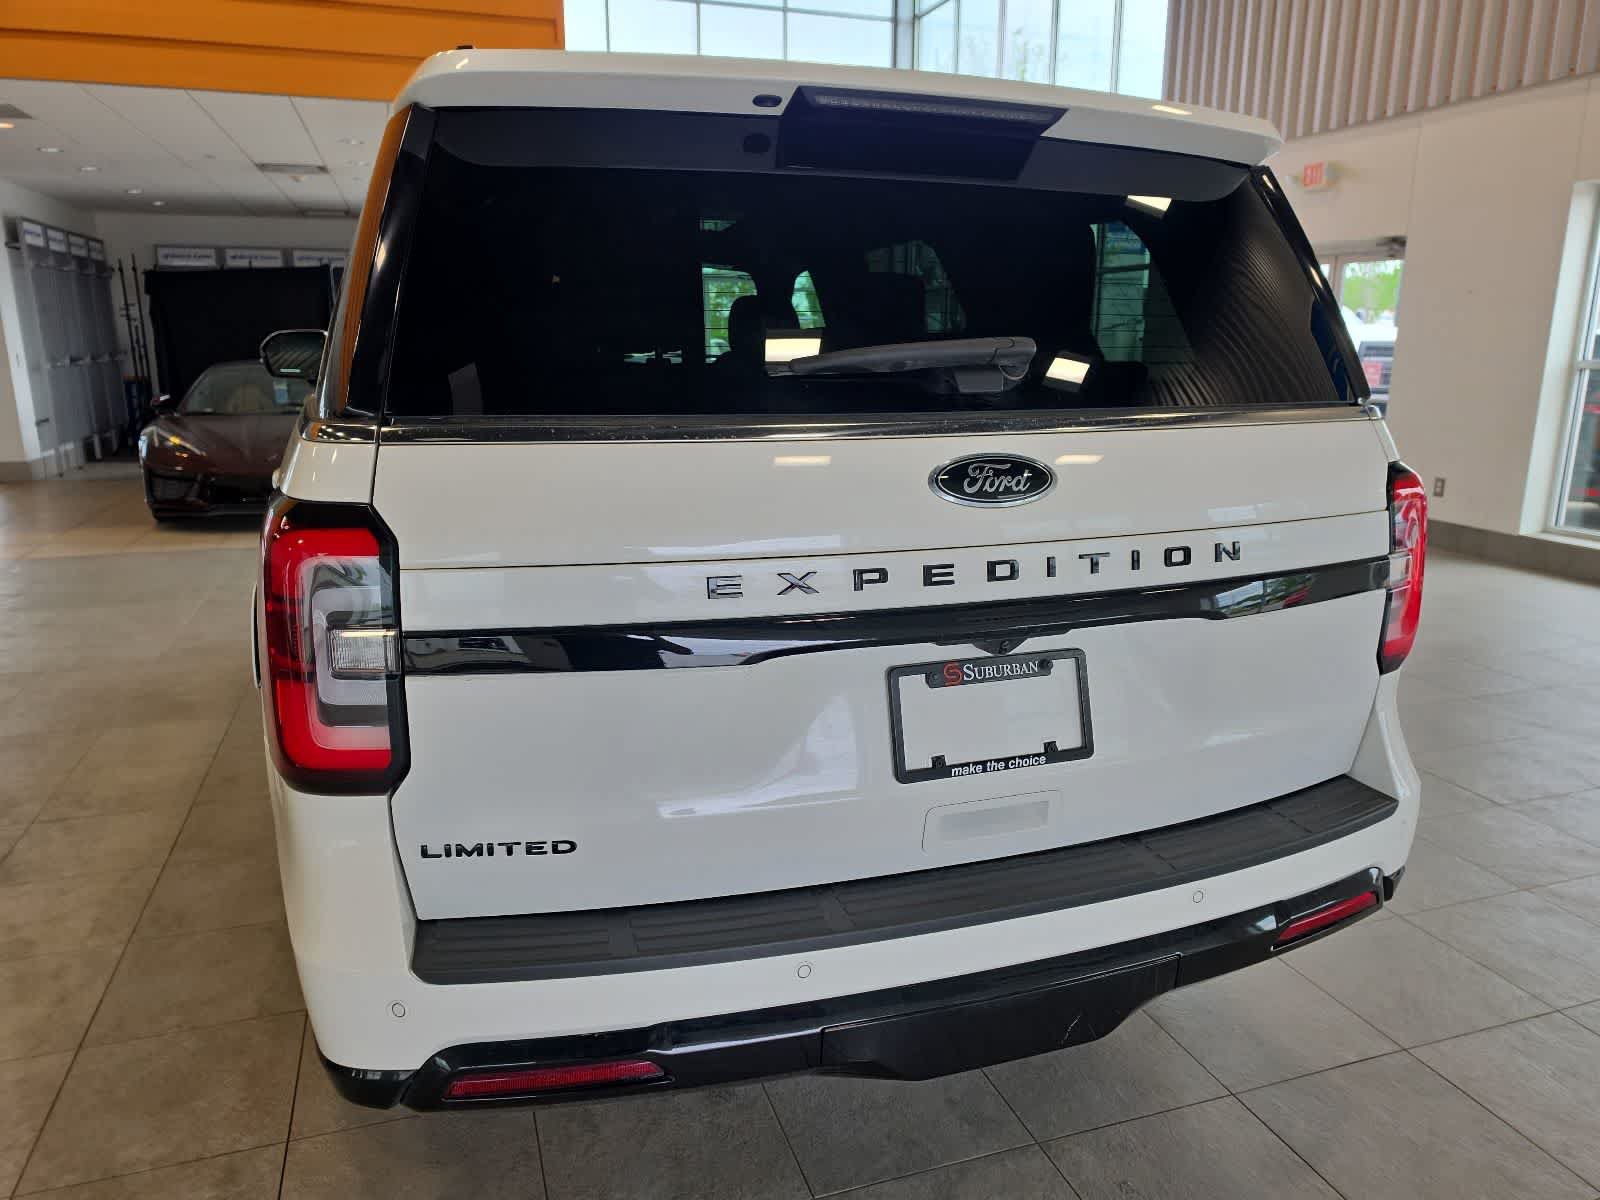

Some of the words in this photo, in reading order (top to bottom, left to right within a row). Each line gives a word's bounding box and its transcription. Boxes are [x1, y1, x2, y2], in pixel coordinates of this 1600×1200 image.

[963, 463, 1031, 493] Ford
[706, 541, 1241, 600] EXPEDITION
[963, 661, 1039, 680] SUBURBAN
[951, 763, 983, 777] make
[986, 760, 1005, 772] the
[1008, 755, 1047, 768] choice
[420, 840, 577, 858] LIMITED
